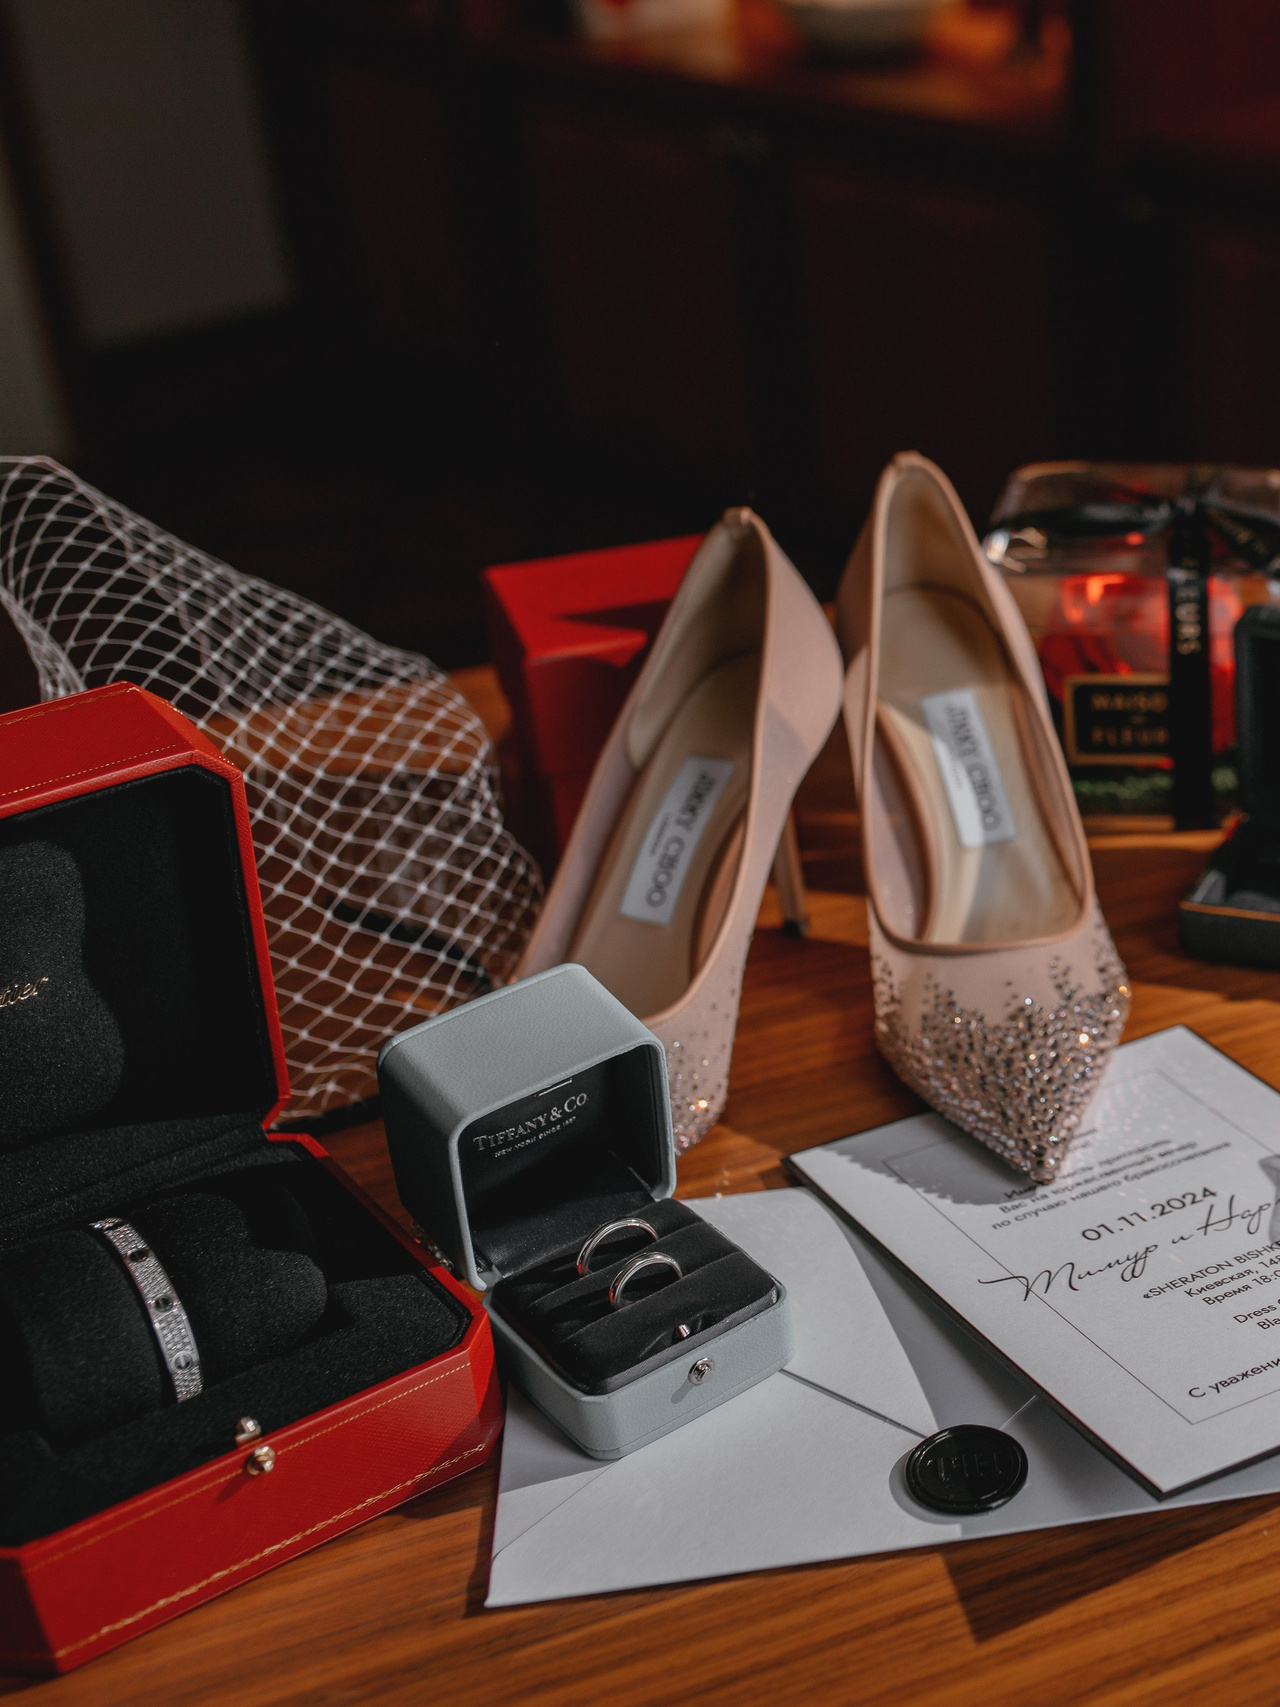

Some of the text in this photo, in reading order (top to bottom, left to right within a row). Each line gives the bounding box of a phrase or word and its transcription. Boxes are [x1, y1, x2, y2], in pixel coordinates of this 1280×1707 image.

[1091, 691, 1169, 712] MAISO
[1091, 726, 1170, 747] FLEUR
[965, 762, 1003, 832] CHOO
[645, 834, 686, 908] CHOO
[0, 976, 49, 1008] tier
[991, 1218, 1012, 1230] по
[1014, 1198, 1068, 1224] случаю
[1071, 1179, 1122, 1202] нашего
[1000, 1200, 1028, 1214] Вас
[1031, 1191, 1049, 1203] на
[1081, 1186, 1218, 1242] 01.11.2024
[977, 1243, 1158, 1302] Тимур
[1171, 1233, 1194, 1245] и
[1143, 1260, 1234, 1299] «SHERATON
[1184, 1268, 1260, 1298] Киевская,
[1202, 1285, 1253, 1306] Время
[1233, 1304, 1277, 1324] Dress
